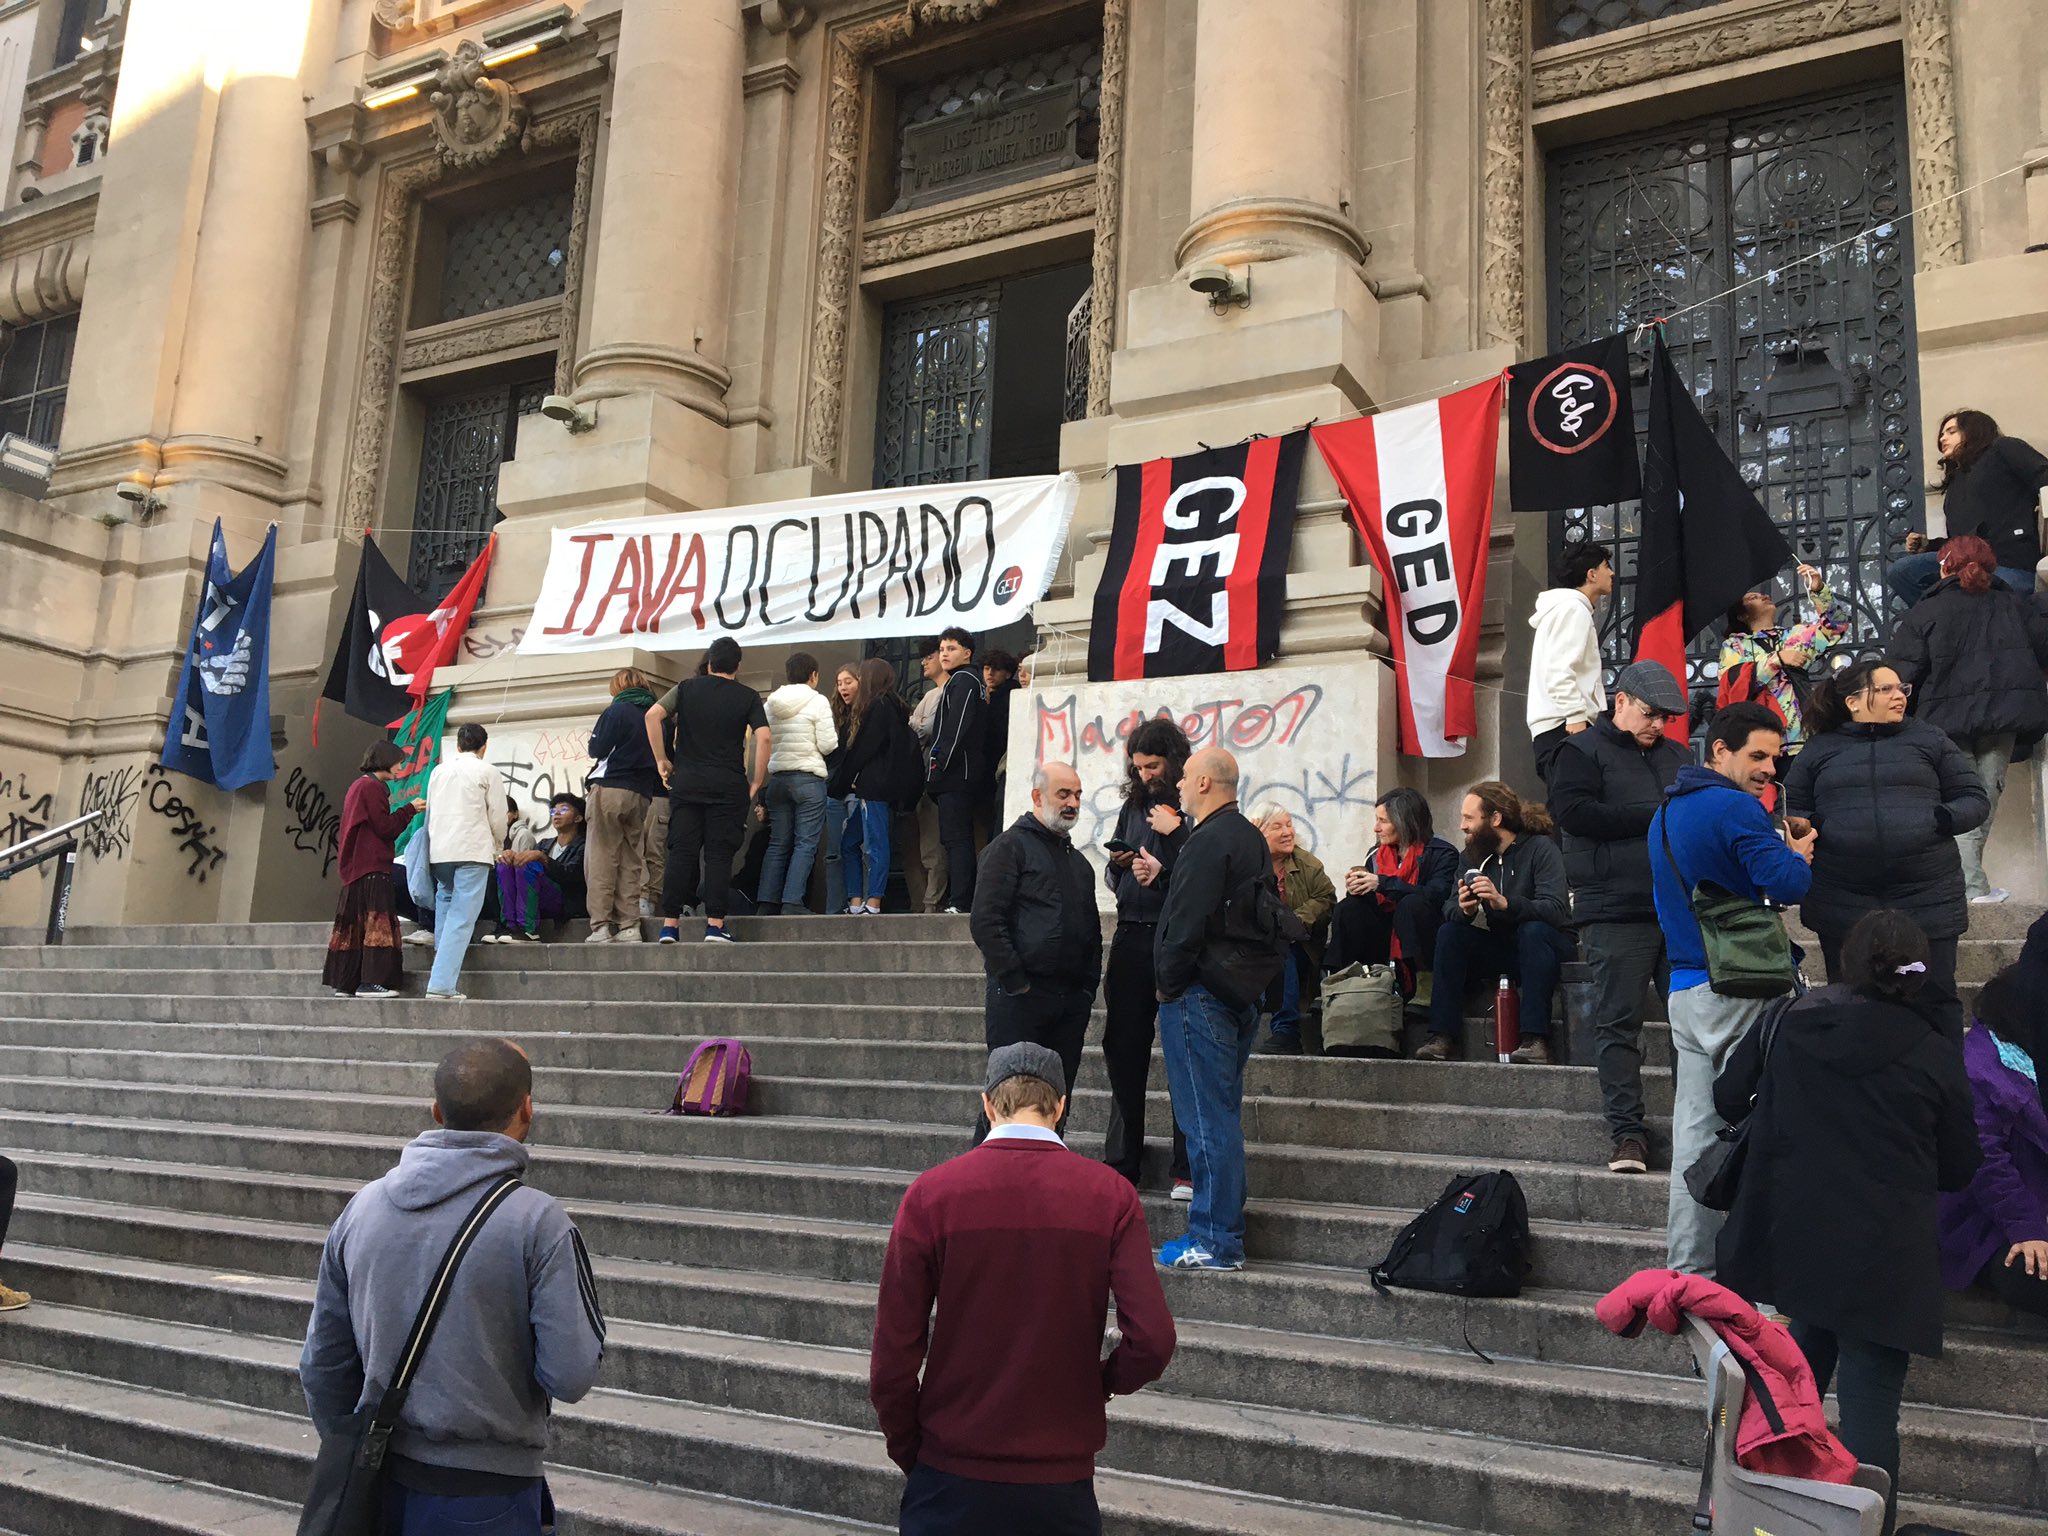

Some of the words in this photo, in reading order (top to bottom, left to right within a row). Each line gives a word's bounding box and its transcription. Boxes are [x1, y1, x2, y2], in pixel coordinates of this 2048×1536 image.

[942, 112, 1039, 152] INSTITUTO
[542, 532, 707, 635] IAVA
[713, 496, 996, 630] OCUPADO
[1143, 475, 1248, 655] GEZ
[1386, 498, 1459, 646] GED
